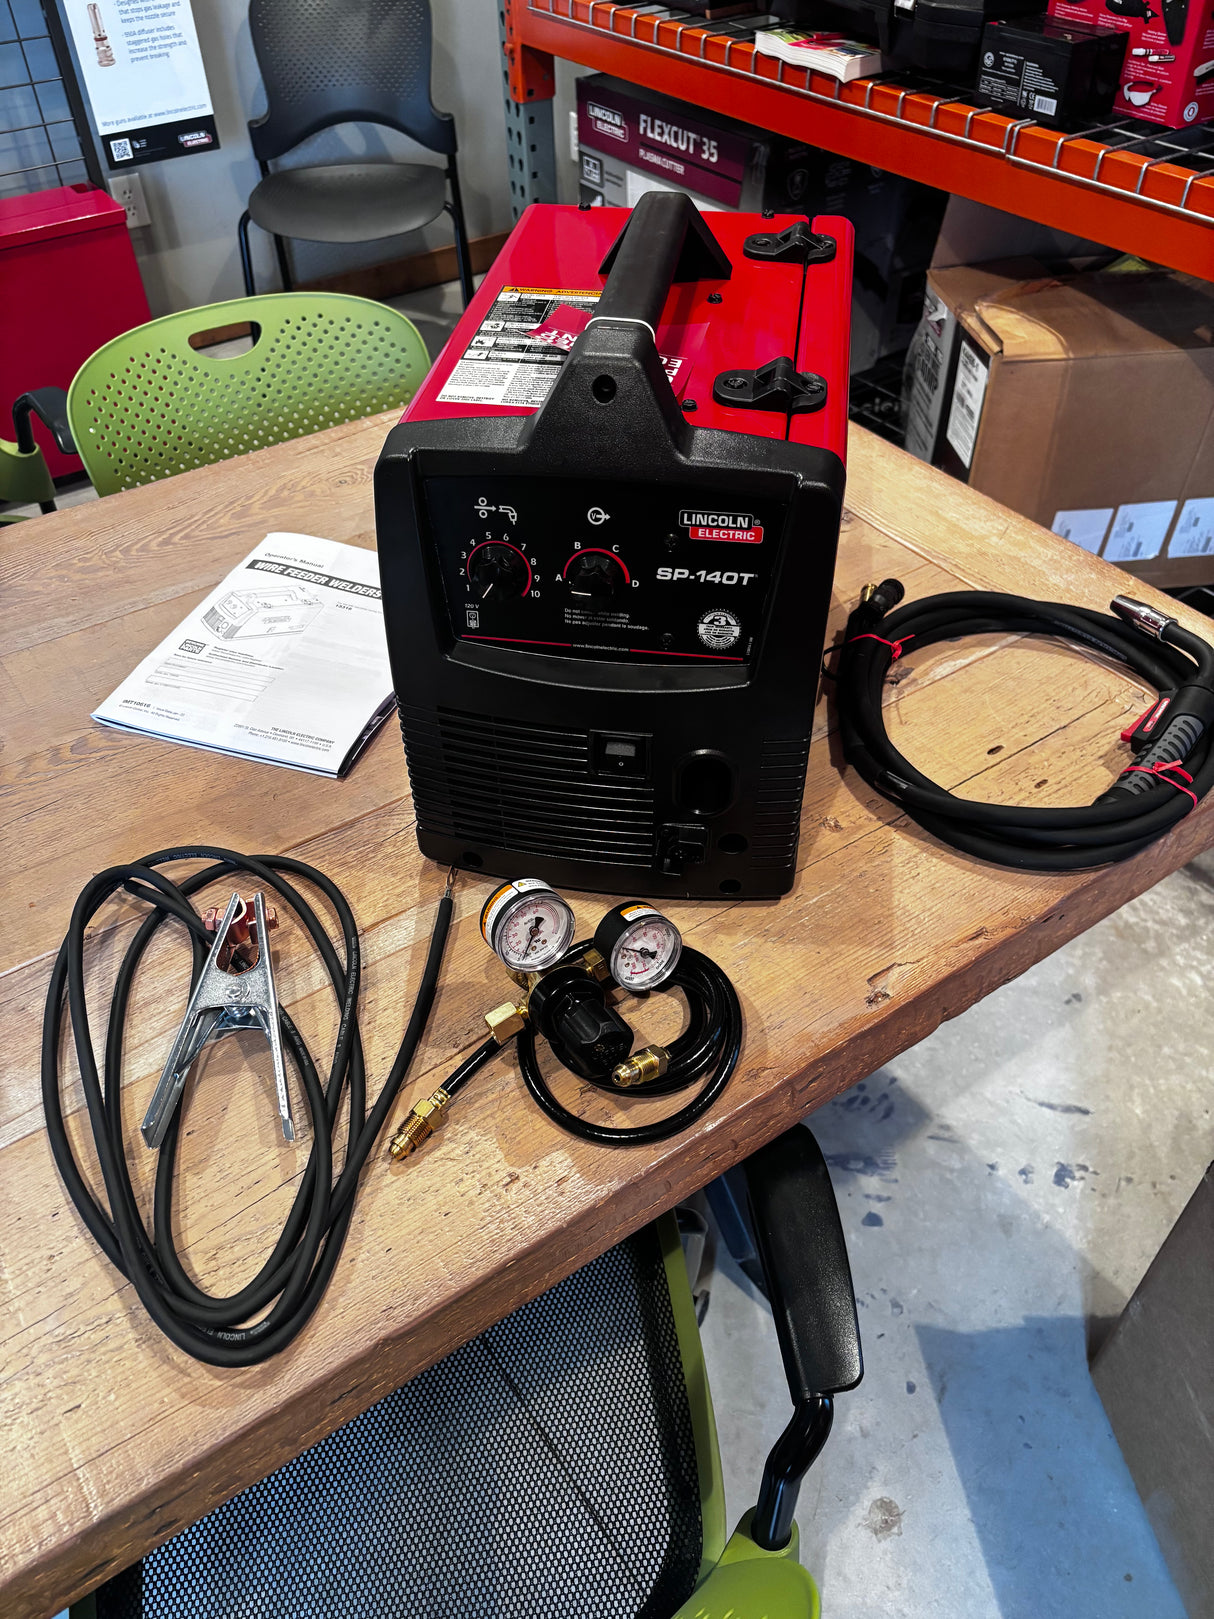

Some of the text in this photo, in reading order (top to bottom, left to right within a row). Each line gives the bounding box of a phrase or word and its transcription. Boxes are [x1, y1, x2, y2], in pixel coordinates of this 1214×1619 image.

[589, 105, 621, 126] LINCOLN
[596, 120, 624, 138] ELECTRIC
[640, 114, 718, 163] FLEXCUT 35
[639, 148, 685, 175] PLASMA CUTTER
[684, 513, 748, 528] LINCOLN
[698, 528, 755, 541] ELECTRIC
[264, 552, 324, 568] Operator's Manual
[254, 561, 382, 598] WIRE FEEDER WELDERS
[555, 574, 562, 582] A
[656, 568, 754, 586] SP-140T
[714, 616, 726, 626] 3
[348, 972, 356, 995] ELECTRIC
[343, 998, 352, 1020] WELDING
[282, 1016, 292, 1030] CABLE
[217, 1332, 246, 1340] LINCOLN
